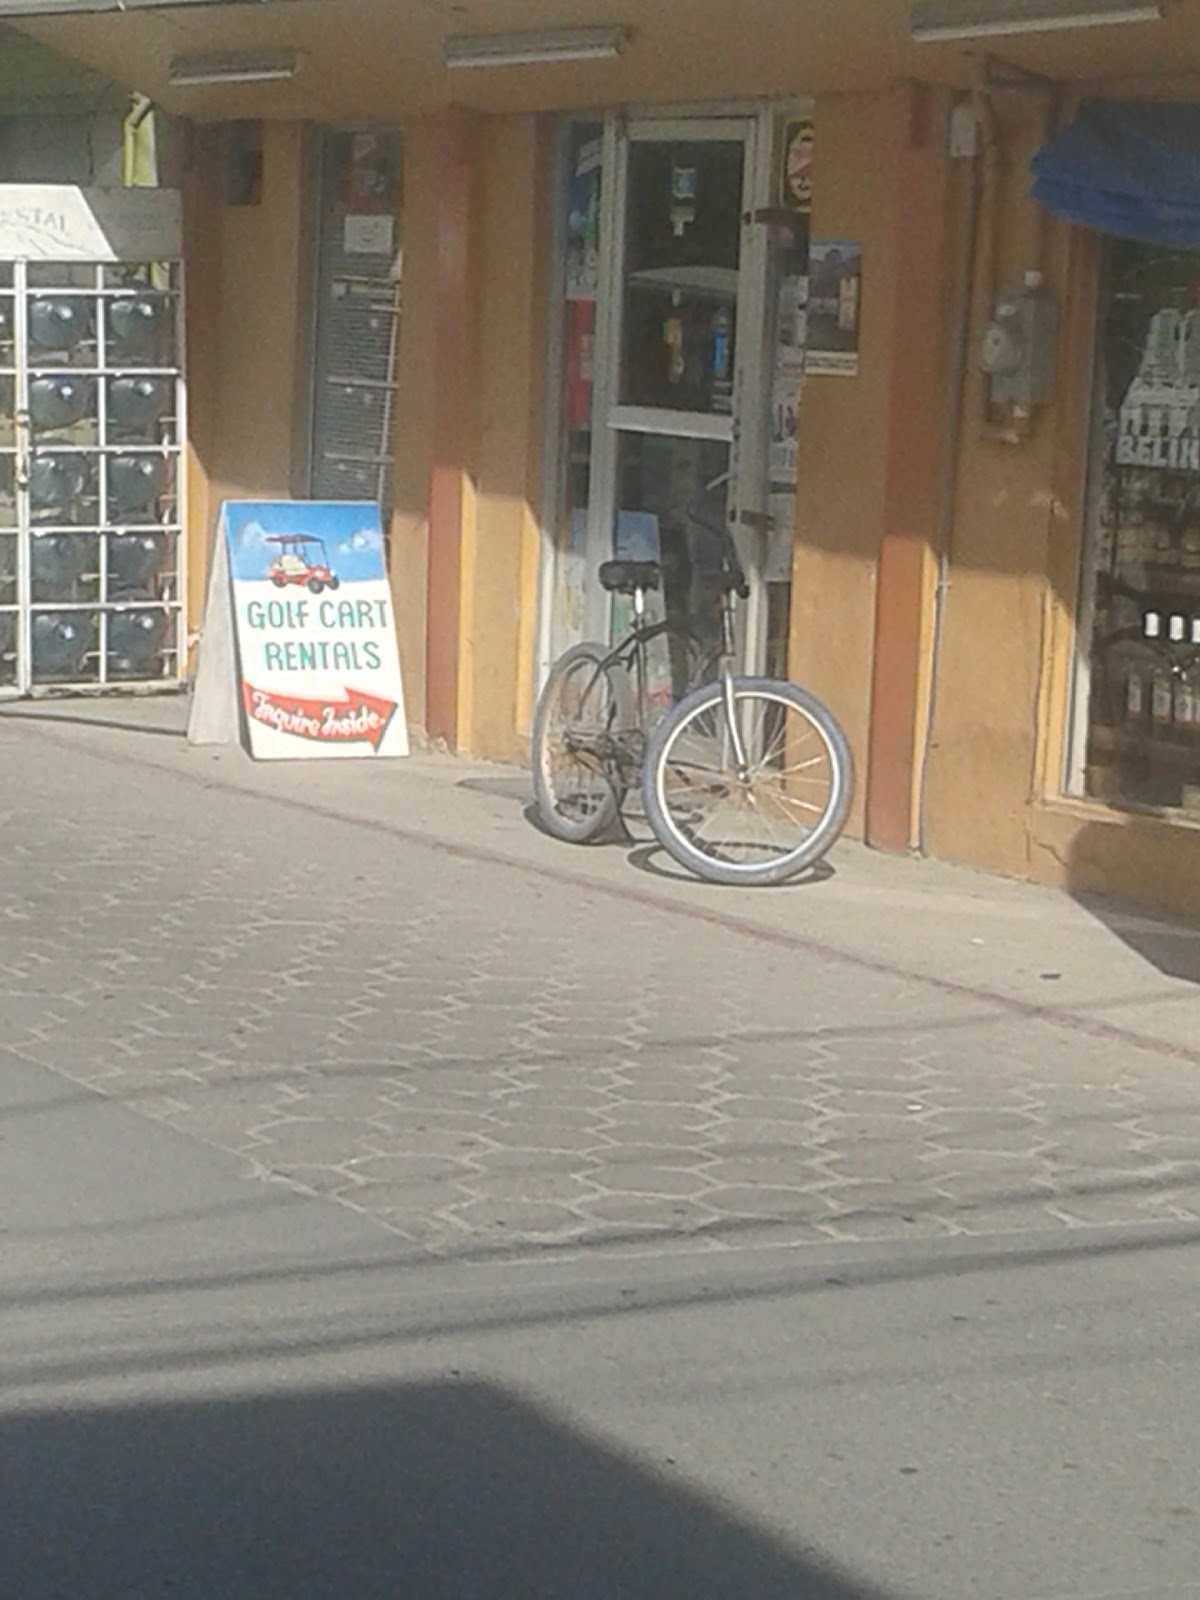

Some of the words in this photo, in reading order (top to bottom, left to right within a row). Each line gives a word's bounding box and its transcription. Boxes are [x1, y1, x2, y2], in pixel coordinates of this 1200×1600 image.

[247, 600, 309, 630] GOLF
[319, 600, 388, 628] CART
[264, 641, 382, 671] RENTALS
[252, 691, 319, 737] Inquire
[321, 703, 385, 736] Inside
